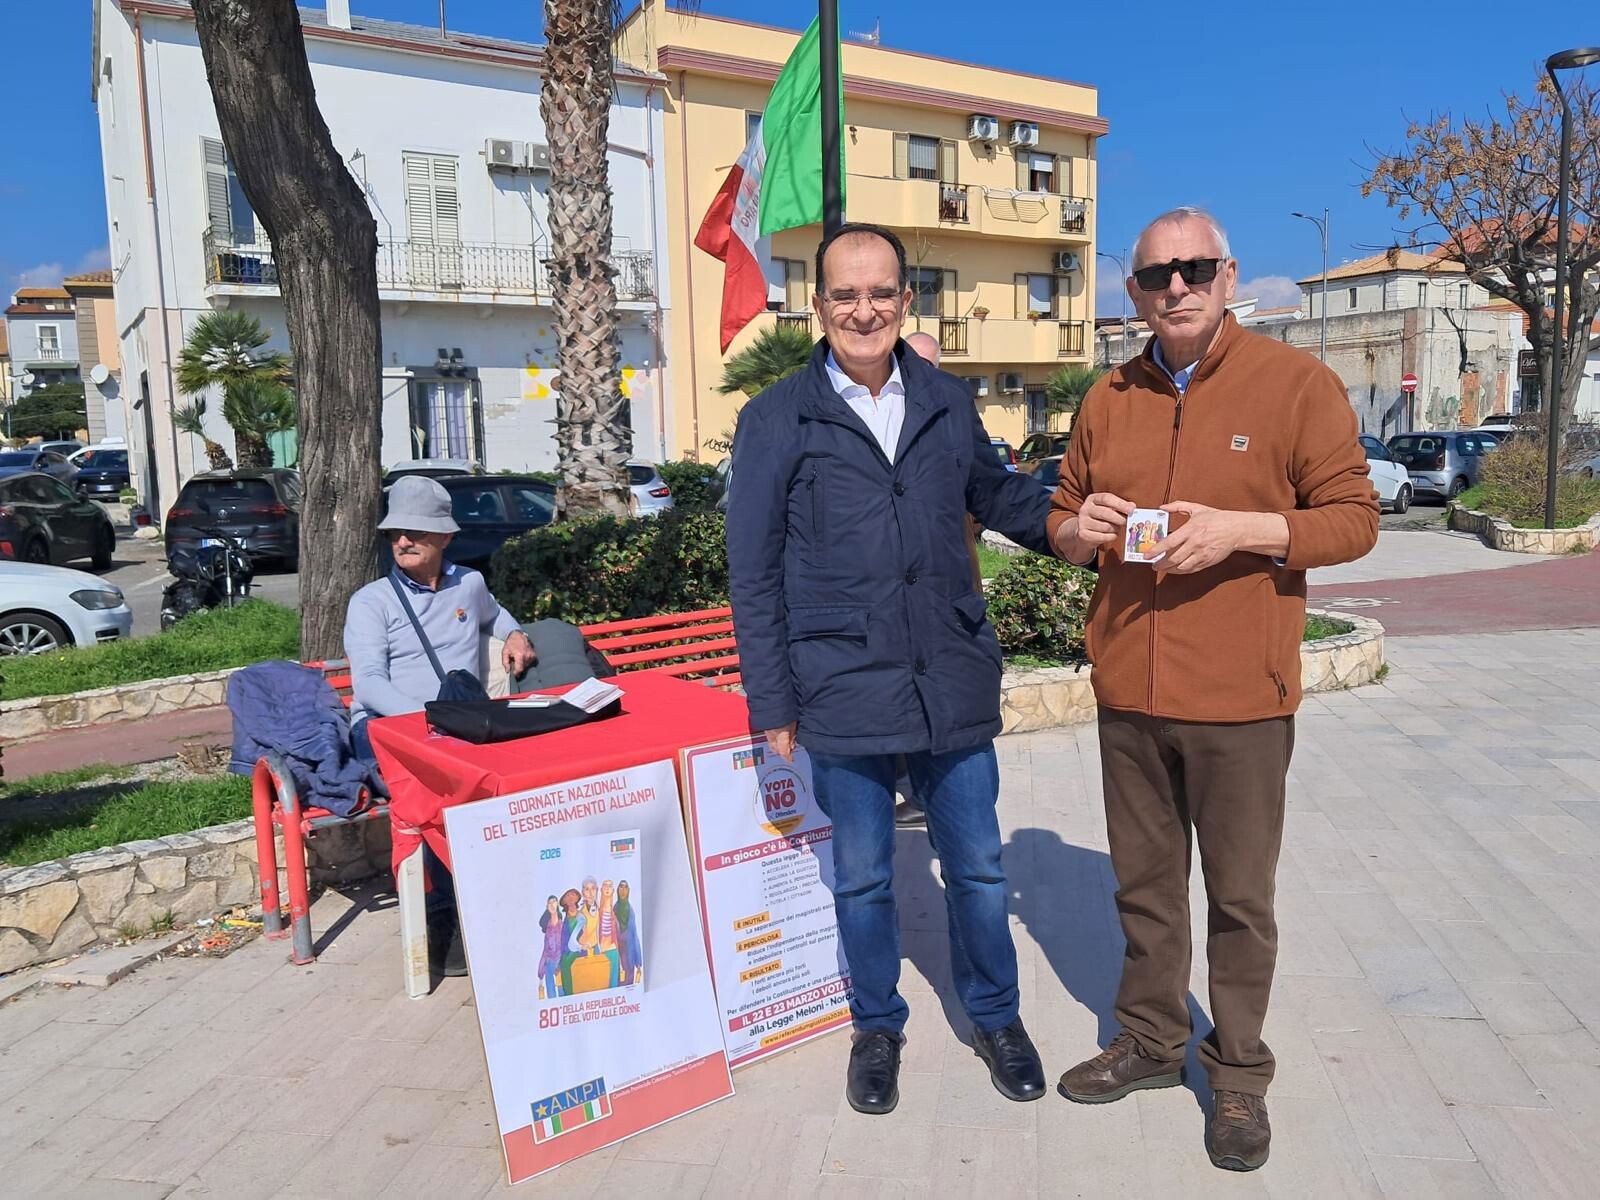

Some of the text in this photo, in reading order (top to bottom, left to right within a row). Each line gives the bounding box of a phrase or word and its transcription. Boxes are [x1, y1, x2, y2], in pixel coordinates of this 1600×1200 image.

[509, 776, 627, 816] GIORNATE NAZIONALI
[765, 778, 794, 793] VOTA
[765, 789, 796, 812] NO
[483, 787, 656, 841] DEL TESSERAMENTO ALL'ANPI
[540, 847, 561, 860] 2026
[721, 855, 731, 865] In
[733, 847, 760, 863] gioco
[762, 842, 777, 854] c'è
[778, 838, 787, 849] la
[761, 857, 782, 867] Questa
[783, 852, 799, 862] legge
[742, 914, 765, 927] INUTILE
[754, 918, 785, 932] separazione
[795, 907, 822, 919] magistrati
[743, 933, 779, 949] PERICOLOSA
[747, 946, 765, 957] Riduce
[766, 934, 804, 951] l'indipendenza
[805, 930, 818, 938] della
[753, 950, 782, 964] indebolisce
[786, 941, 808, 953] controlli
[817, 933, 835, 943] potere
[749, 962, 779, 978] RISULTATO
[754, 977, 765, 985] forti
[766, 971, 784, 981] ancora
[785, 967, 794, 976] più
[795, 963, 806, 971] forti
[755, 984, 771, 994] deboli
[773, 978, 791, 987] ancora
[792, 973, 800, 982] più
[563, 1003, 584, 1014] DELLA
[586, 996, 626, 1010] REPUBBLICA
[727, 1007, 738, 1016] Per
[739, 998, 765, 1012] difendere
[772, 983, 806, 999] Costituzione
[742, 1015, 751, 1026] IL
[752, 1009, 765, 1021] 22
[765, 1007, 772, 1016] E
[773, 1002, 785, 1013] 23
[786, 990, 820, 1010] MARZO
[820, 979, 847, 996] VOTA
[563, 1003, 640, 1025] E DEL VOTO ALLE DONNE
[749, 1026, 765, 1037] alla
[766, 1013, 794, 1030] Legge
[796, 1002, 824, 1019] Meloni
[550, 1079, 605, 1114] A.N.P.I.
